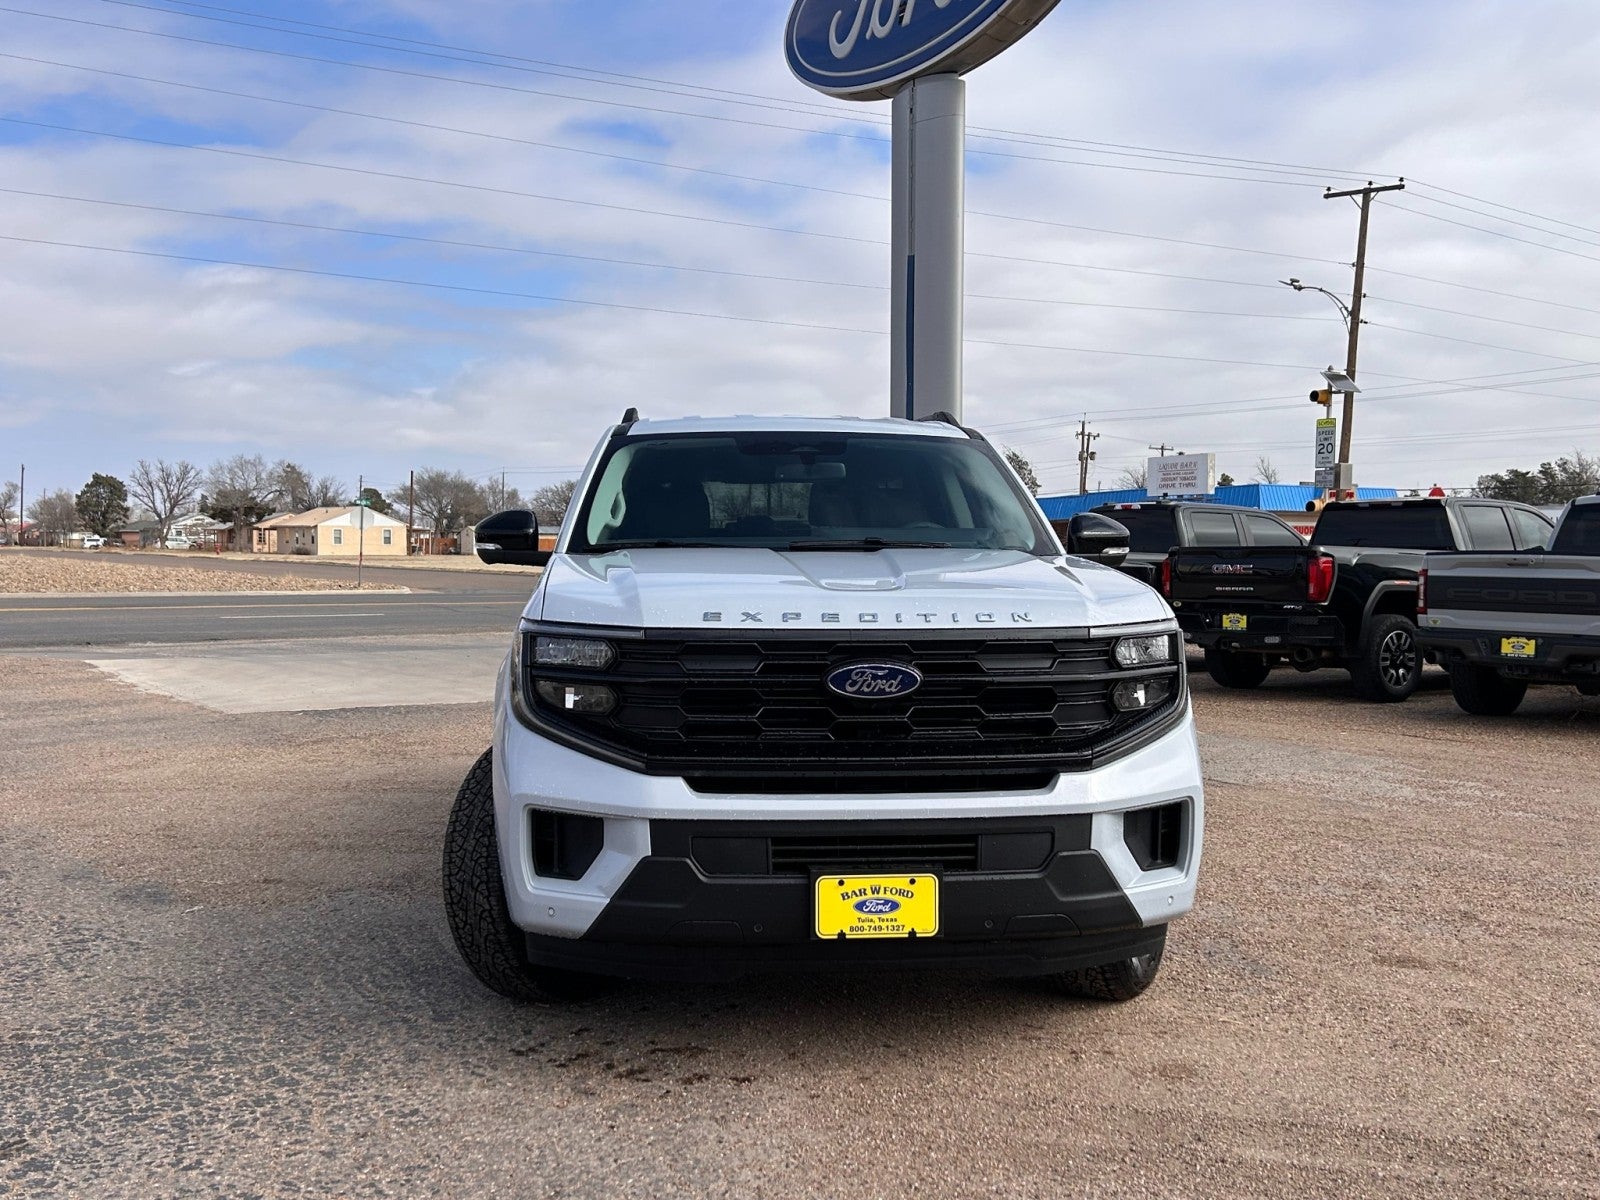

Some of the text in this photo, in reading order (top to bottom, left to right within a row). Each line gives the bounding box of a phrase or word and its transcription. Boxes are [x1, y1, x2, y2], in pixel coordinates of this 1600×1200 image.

[1318, 443, 1334, 454] 20
[1212, 564, 1253, 574] GMC
[1447, 587, 1597, 604] FORD
[702, 611, 1033, 624] EXPEDITION
[845, 668, 903, 694] Ford
[840, 884, 914, 901] BAR W FORD
[862, 899, 891, 912] Ford
